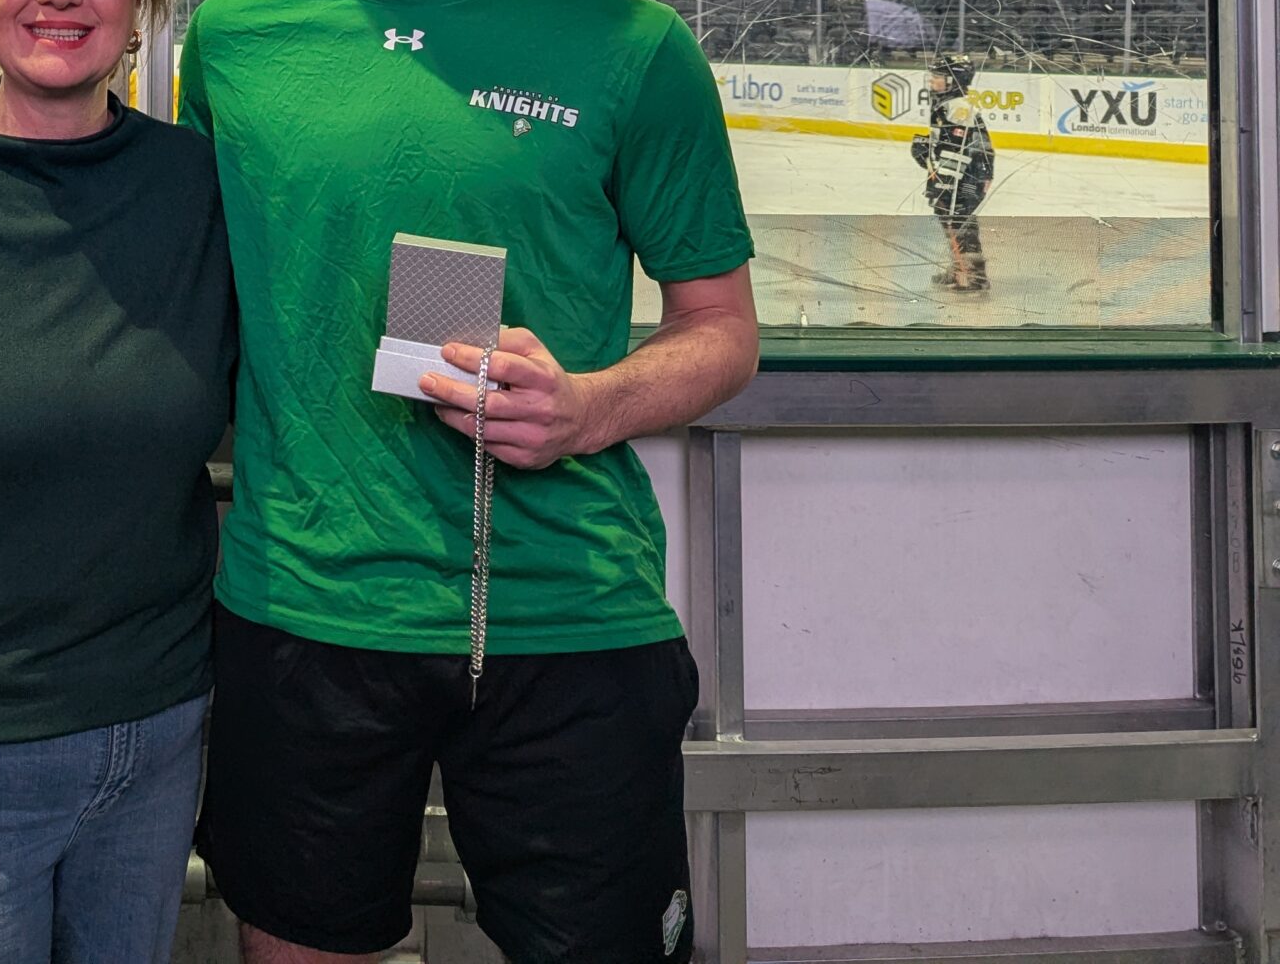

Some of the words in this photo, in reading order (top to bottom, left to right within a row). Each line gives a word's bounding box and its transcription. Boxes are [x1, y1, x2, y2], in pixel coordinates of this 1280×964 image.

[494, 86, 542, 99] PROPERTY
[732, 74, 783, 102] Libro
[797, 84, 815, 93] Let's
[817, 84, 839, 94] make
[791, 96, 817, 107] money
[1071, 88, 1157, 127] YXU
[1164, 97, 1193, 109] start
[469, 89, 579, 128] KNIGHTS
[1182, 113, 1198, 126] go
[1072, 122, 1106, 133] London
